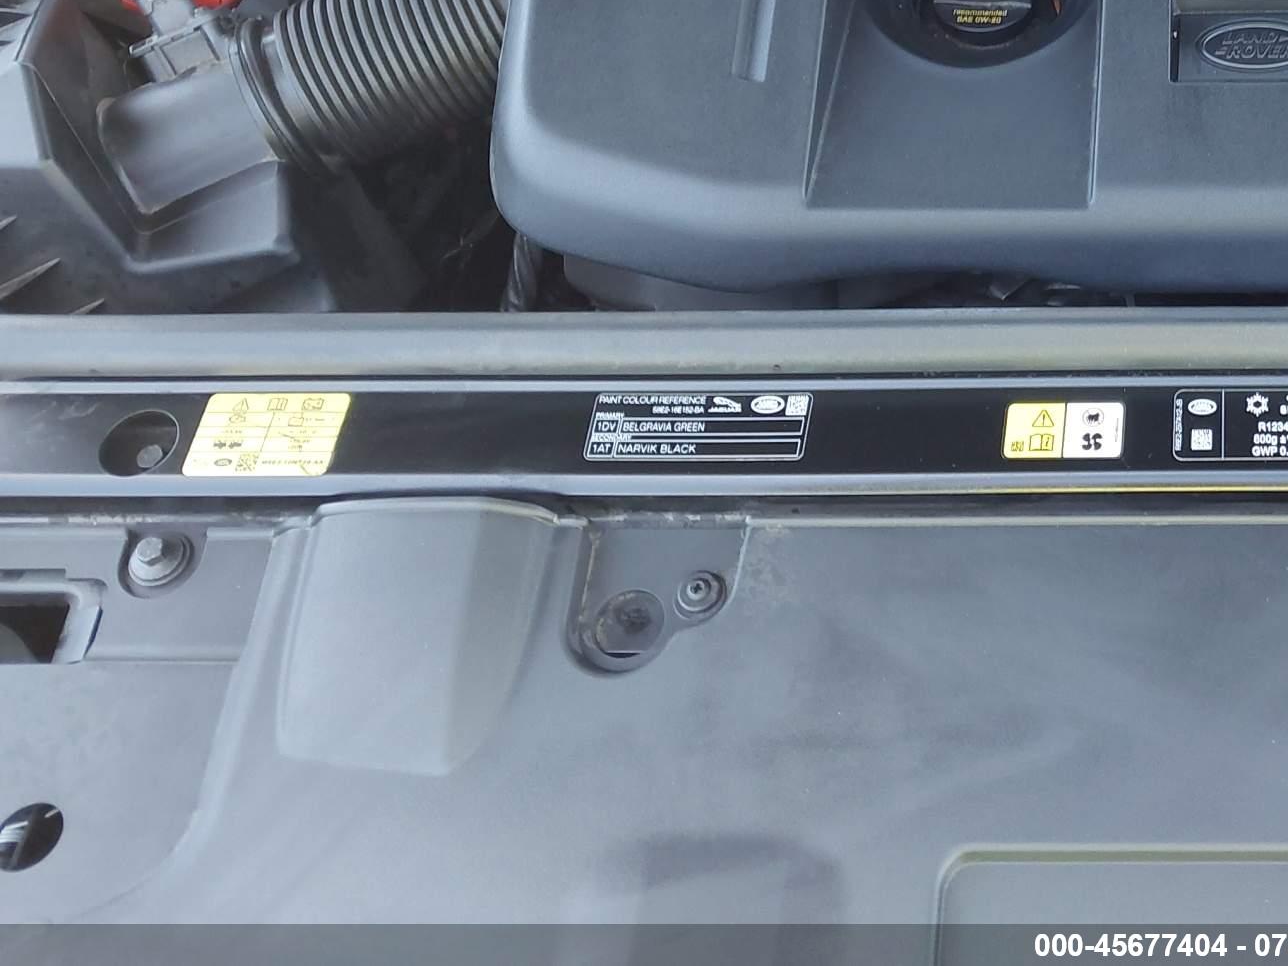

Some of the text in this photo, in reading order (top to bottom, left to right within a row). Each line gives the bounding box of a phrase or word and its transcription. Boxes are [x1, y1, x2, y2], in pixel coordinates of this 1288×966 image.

[1222, 33, 1279, 45] LAND
[599, 396, 707, 405] PAINT COLOUR REFERENCE
[597, 422, 705, 432] 1DV BELGRAVIA GREEN
[592, 444, 697, 453] 1AT NARVIK BLACK
[1252, 446, 1278, 456] GWP
